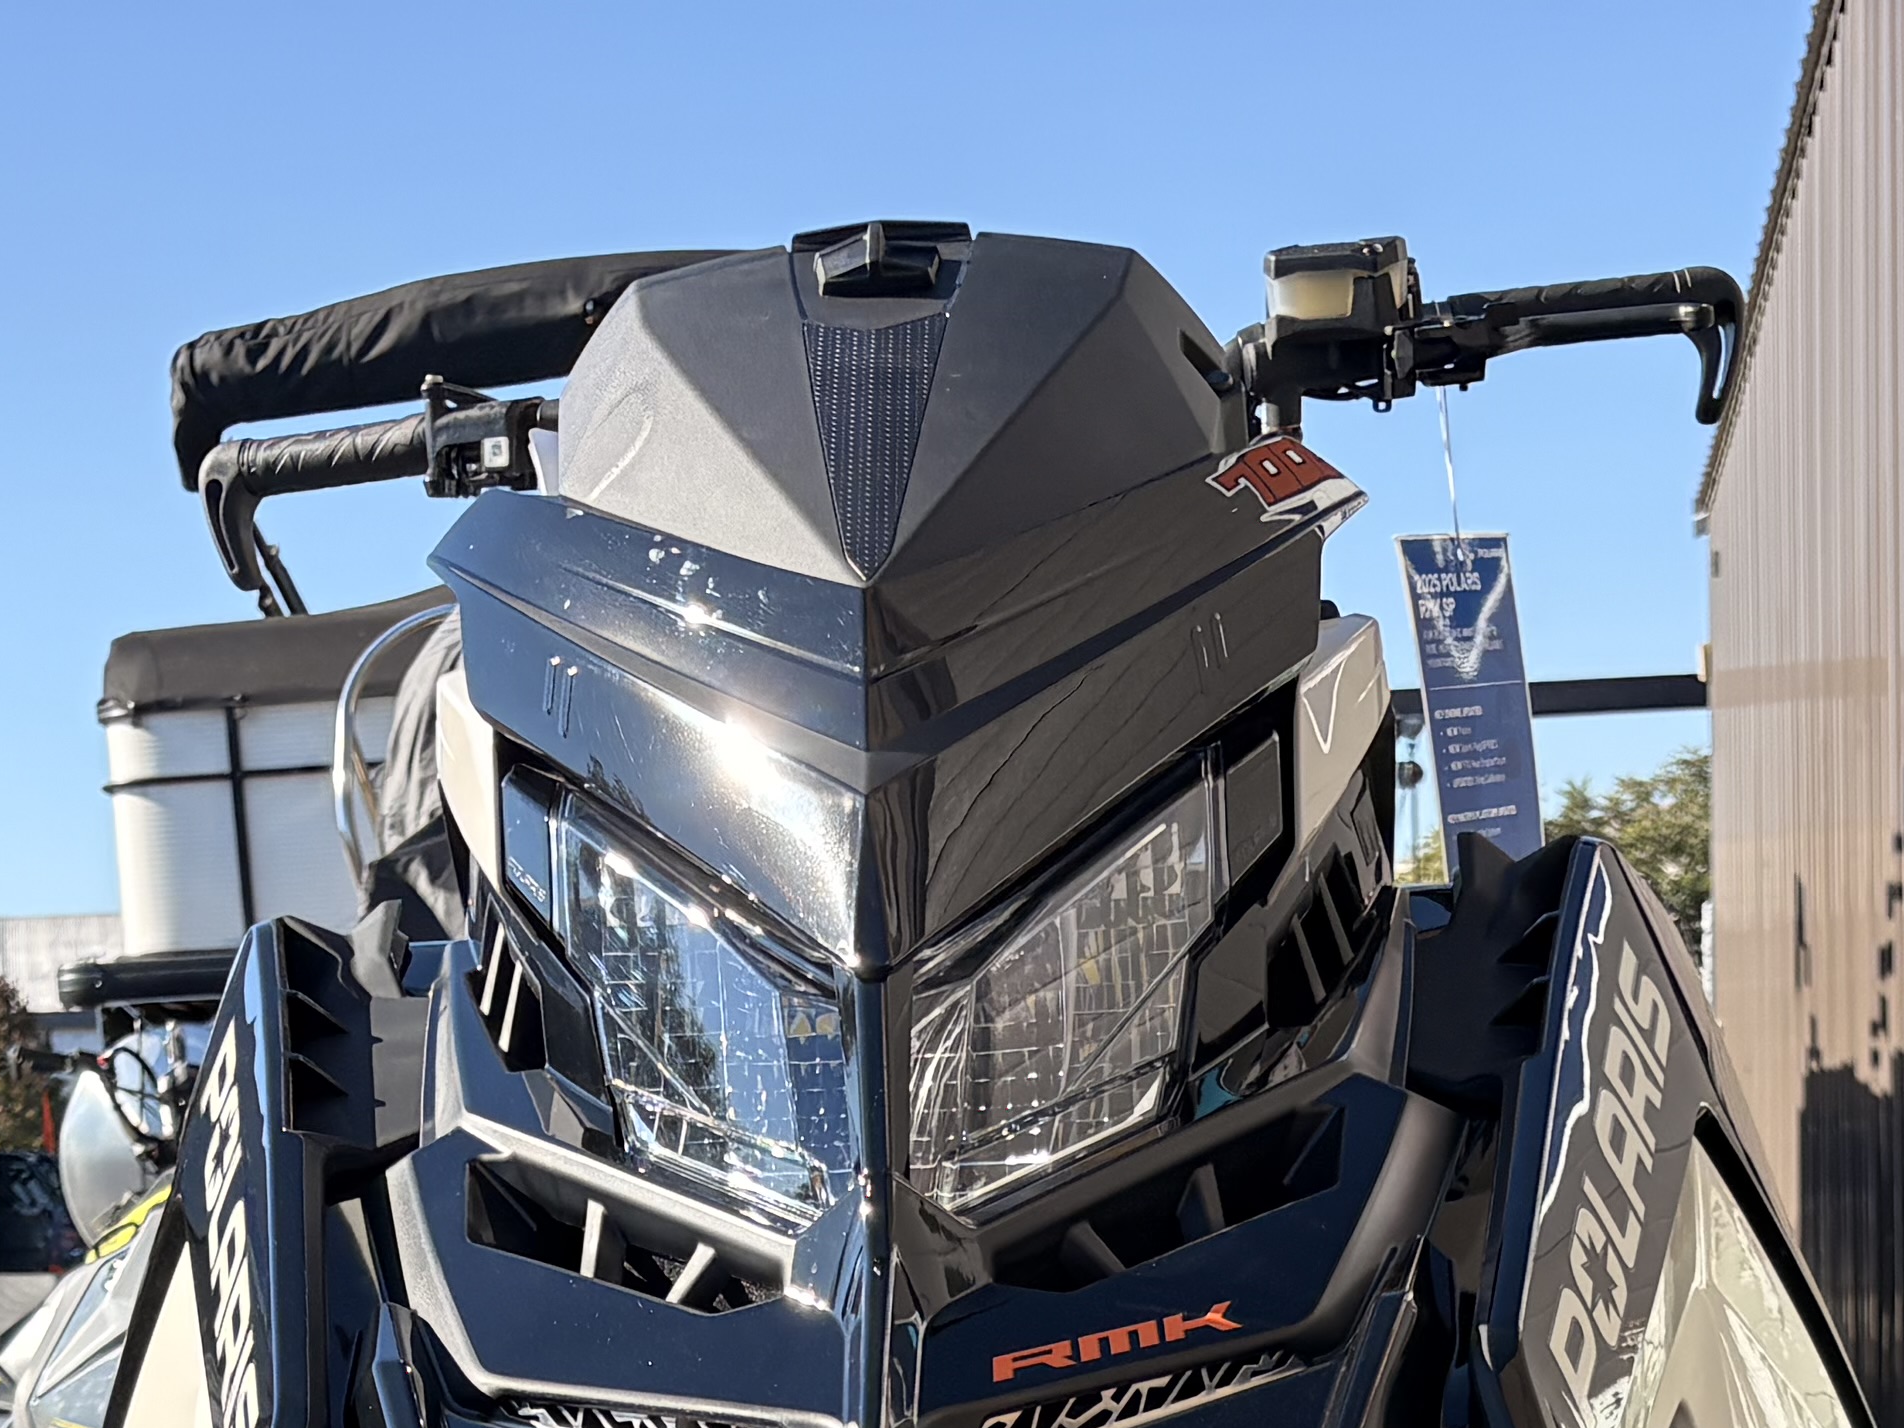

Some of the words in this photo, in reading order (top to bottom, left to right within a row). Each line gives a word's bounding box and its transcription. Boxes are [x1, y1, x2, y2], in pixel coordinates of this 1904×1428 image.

[1208, 436, 1345, 509] 700
[1441, 571, 1482, 593] POLARIS
[992, 1300, 1244, 1384] RMK
